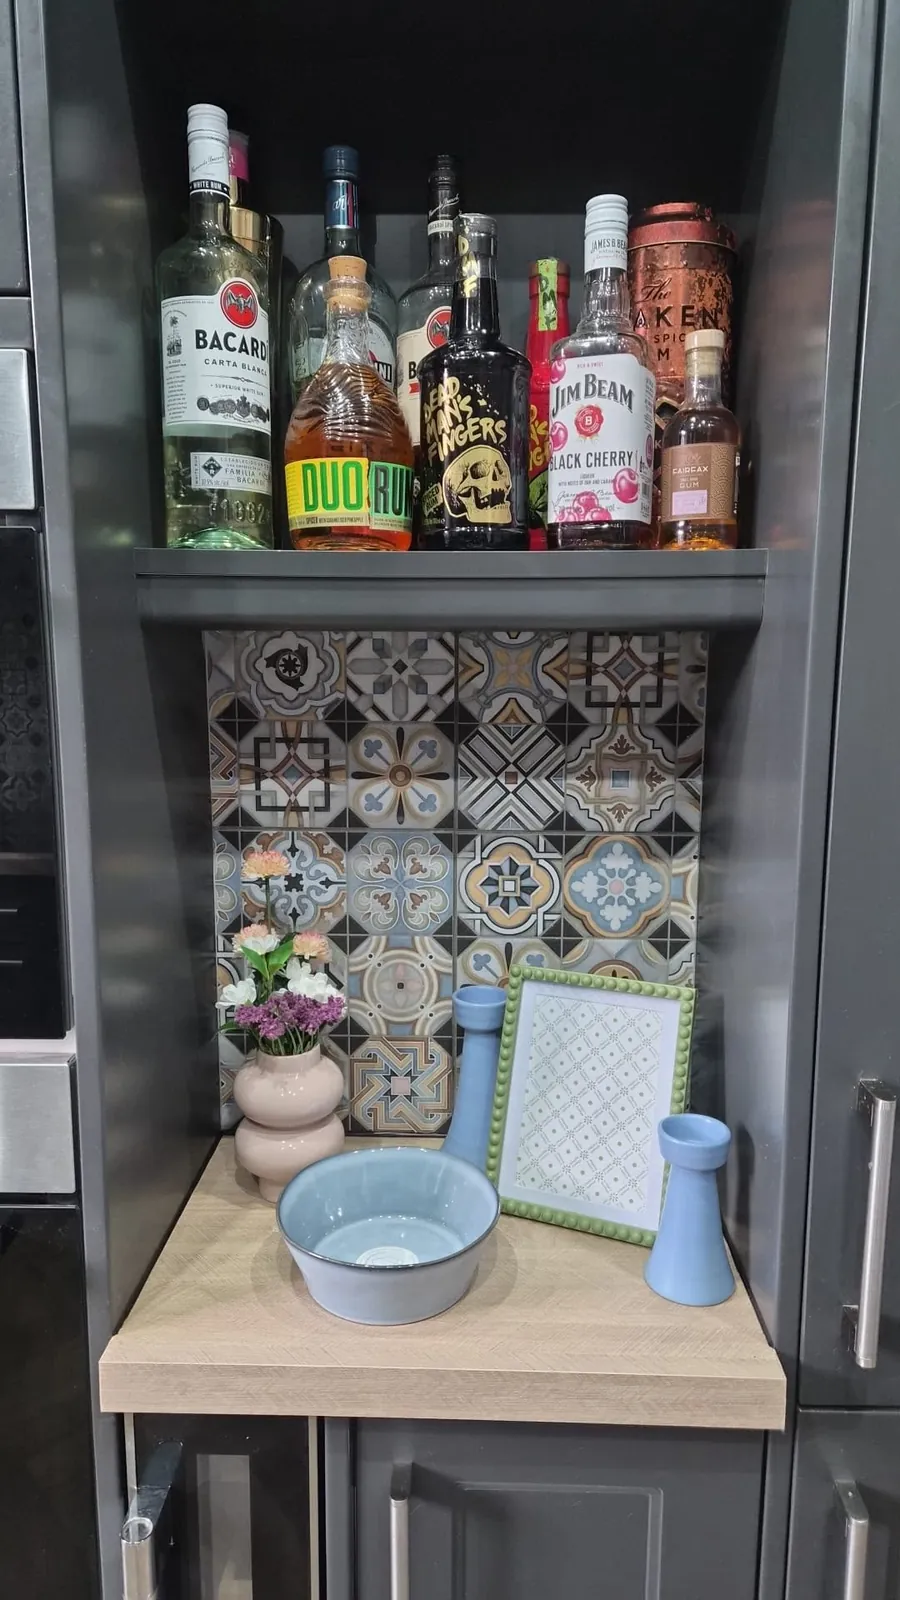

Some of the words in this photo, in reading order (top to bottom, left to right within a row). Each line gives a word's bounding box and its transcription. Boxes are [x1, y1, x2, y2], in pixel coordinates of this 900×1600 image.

[193, 180, 209, 189] WHITE
[210, 182, 222, 191] RUM
[635, 277, 673, 302] The
[634, 304, 719, 330] AKEN
[653, 333, 686, 344] SPIC
[204, 358, 238, 369] CARTA
[241, 362, 268, 377] BLANCA
[215, 383, 241, 392] SUPERIOR
[552, 382, 581, 418] JIM
[584, 373, 634, 414] BEAM
[424, 376, 461, 424] DEAD
[427, 394, 473, 444] MAN'S
[585, 415, 593, 425] B
[428, 417, 507, 467] FINGERS
[550, 453, 582, 472] BLACK
[586, 450, 634, 469] CHERRY
[672, 465, 709, 475] FAIRFAX
[302, 460, 364, 512] DUO
